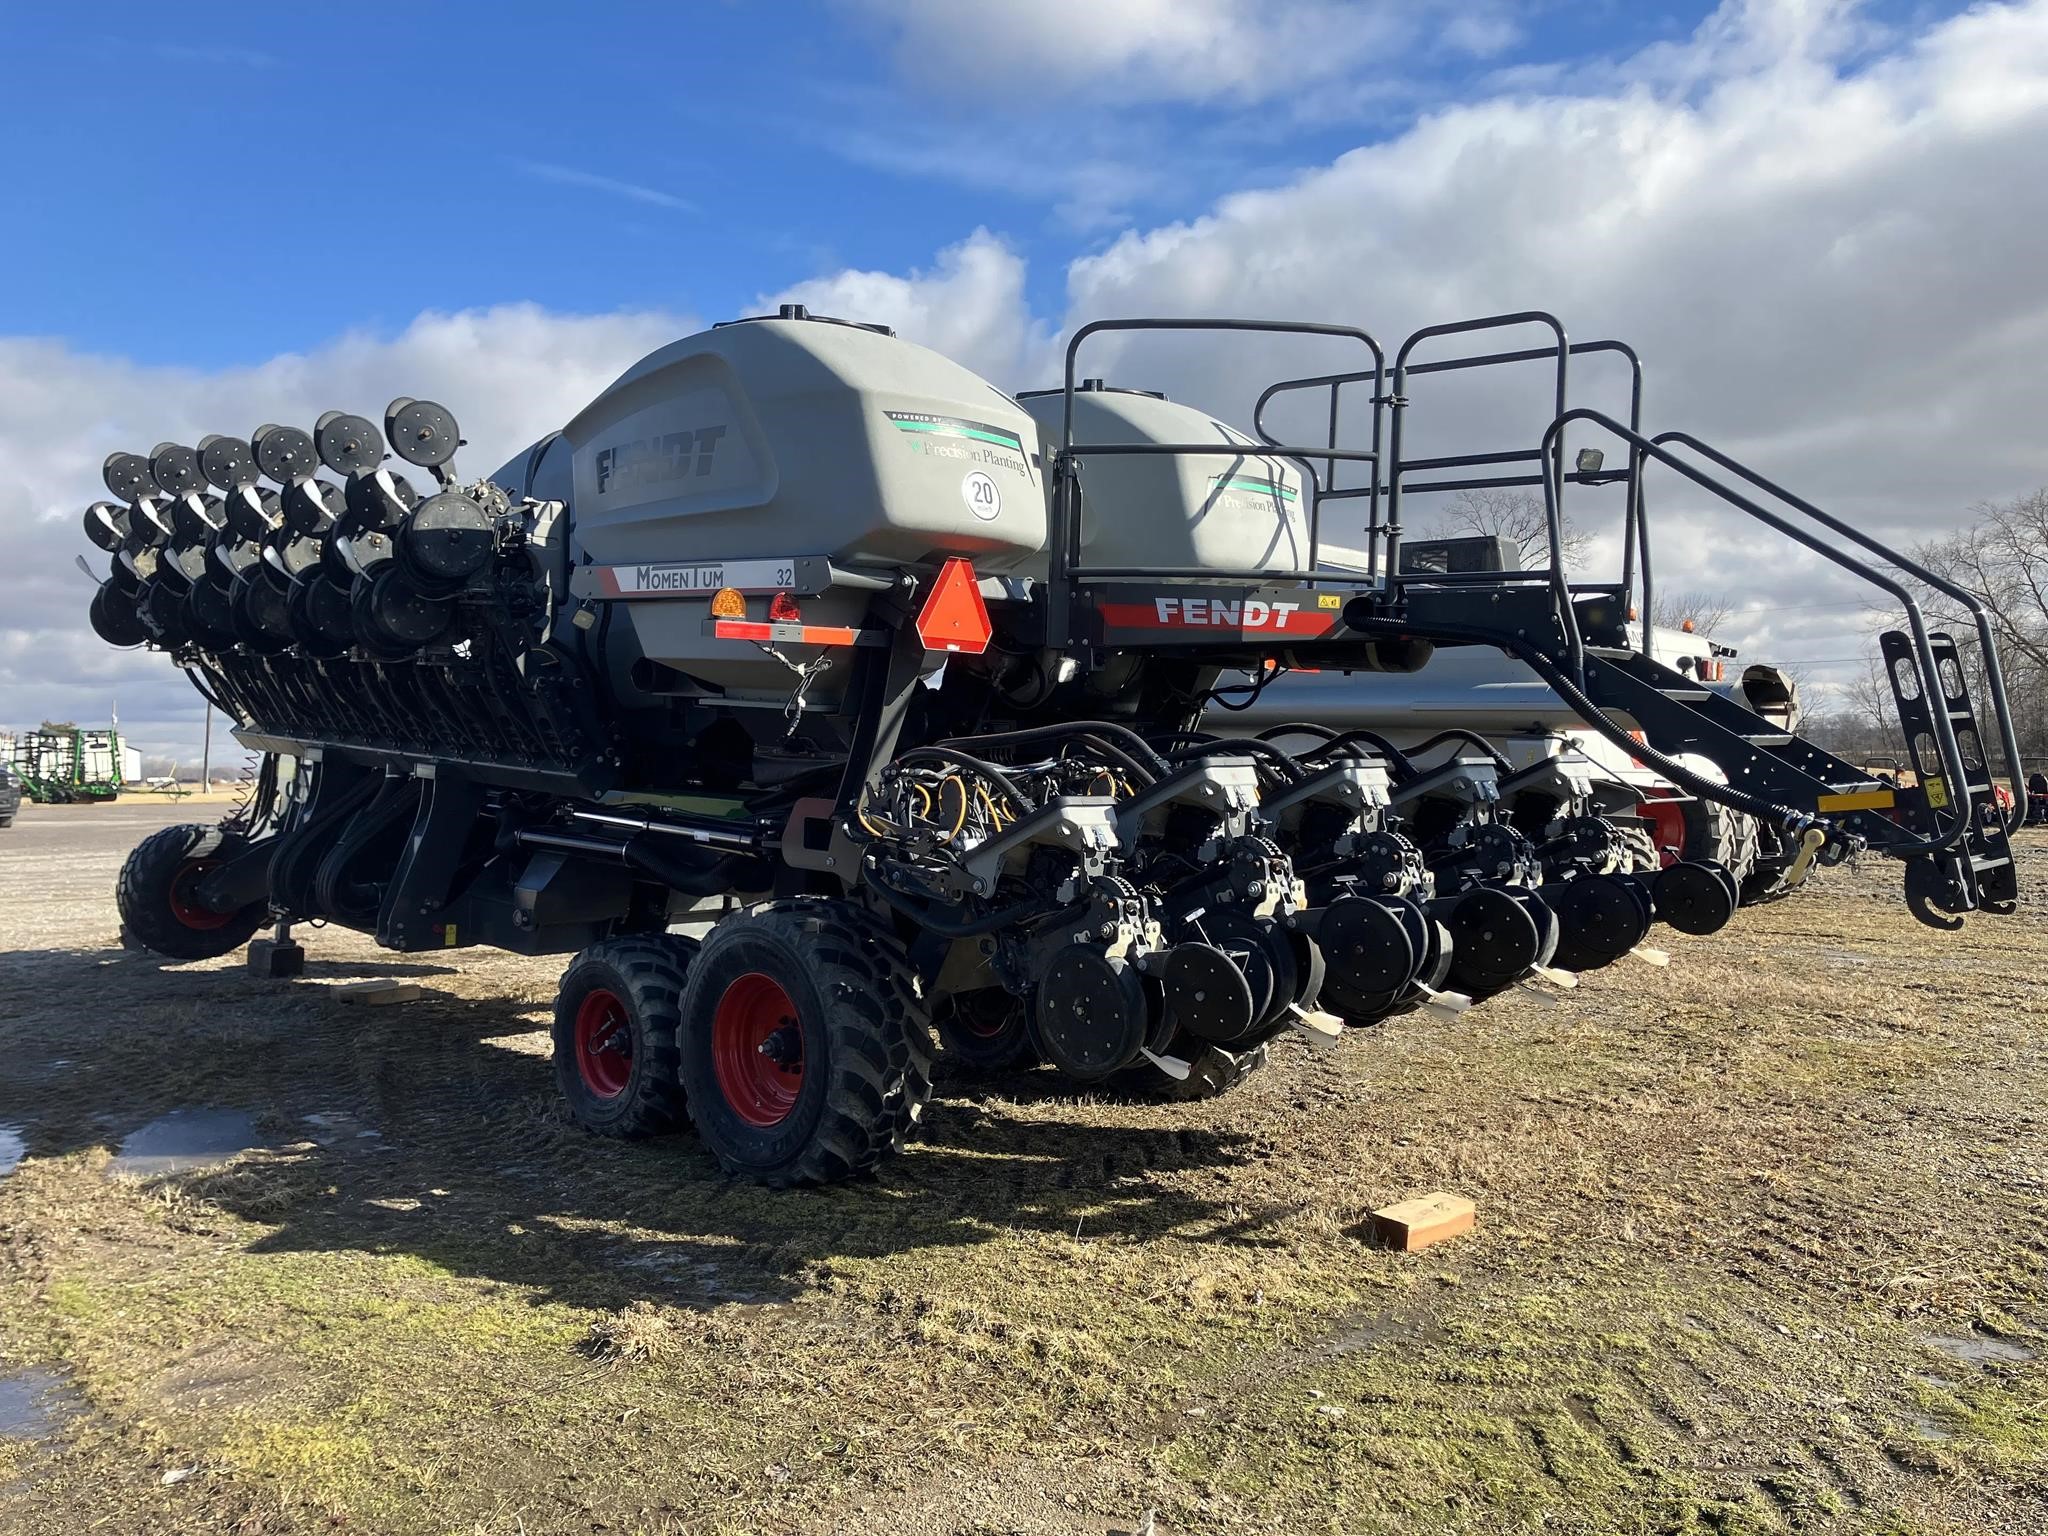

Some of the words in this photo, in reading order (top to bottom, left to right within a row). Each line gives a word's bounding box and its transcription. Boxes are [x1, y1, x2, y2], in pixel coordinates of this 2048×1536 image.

[892, 413, 930, 422] POWERED
[932, 416, 942, 424] BY
[924, 440, 981, 463] Precision
[983, 449, 1026, 477] Planting
[972, 481, 993, 504] 20
[776, 568, 792, 586] 32
[1155, 597, 1300, 628] FENDT
